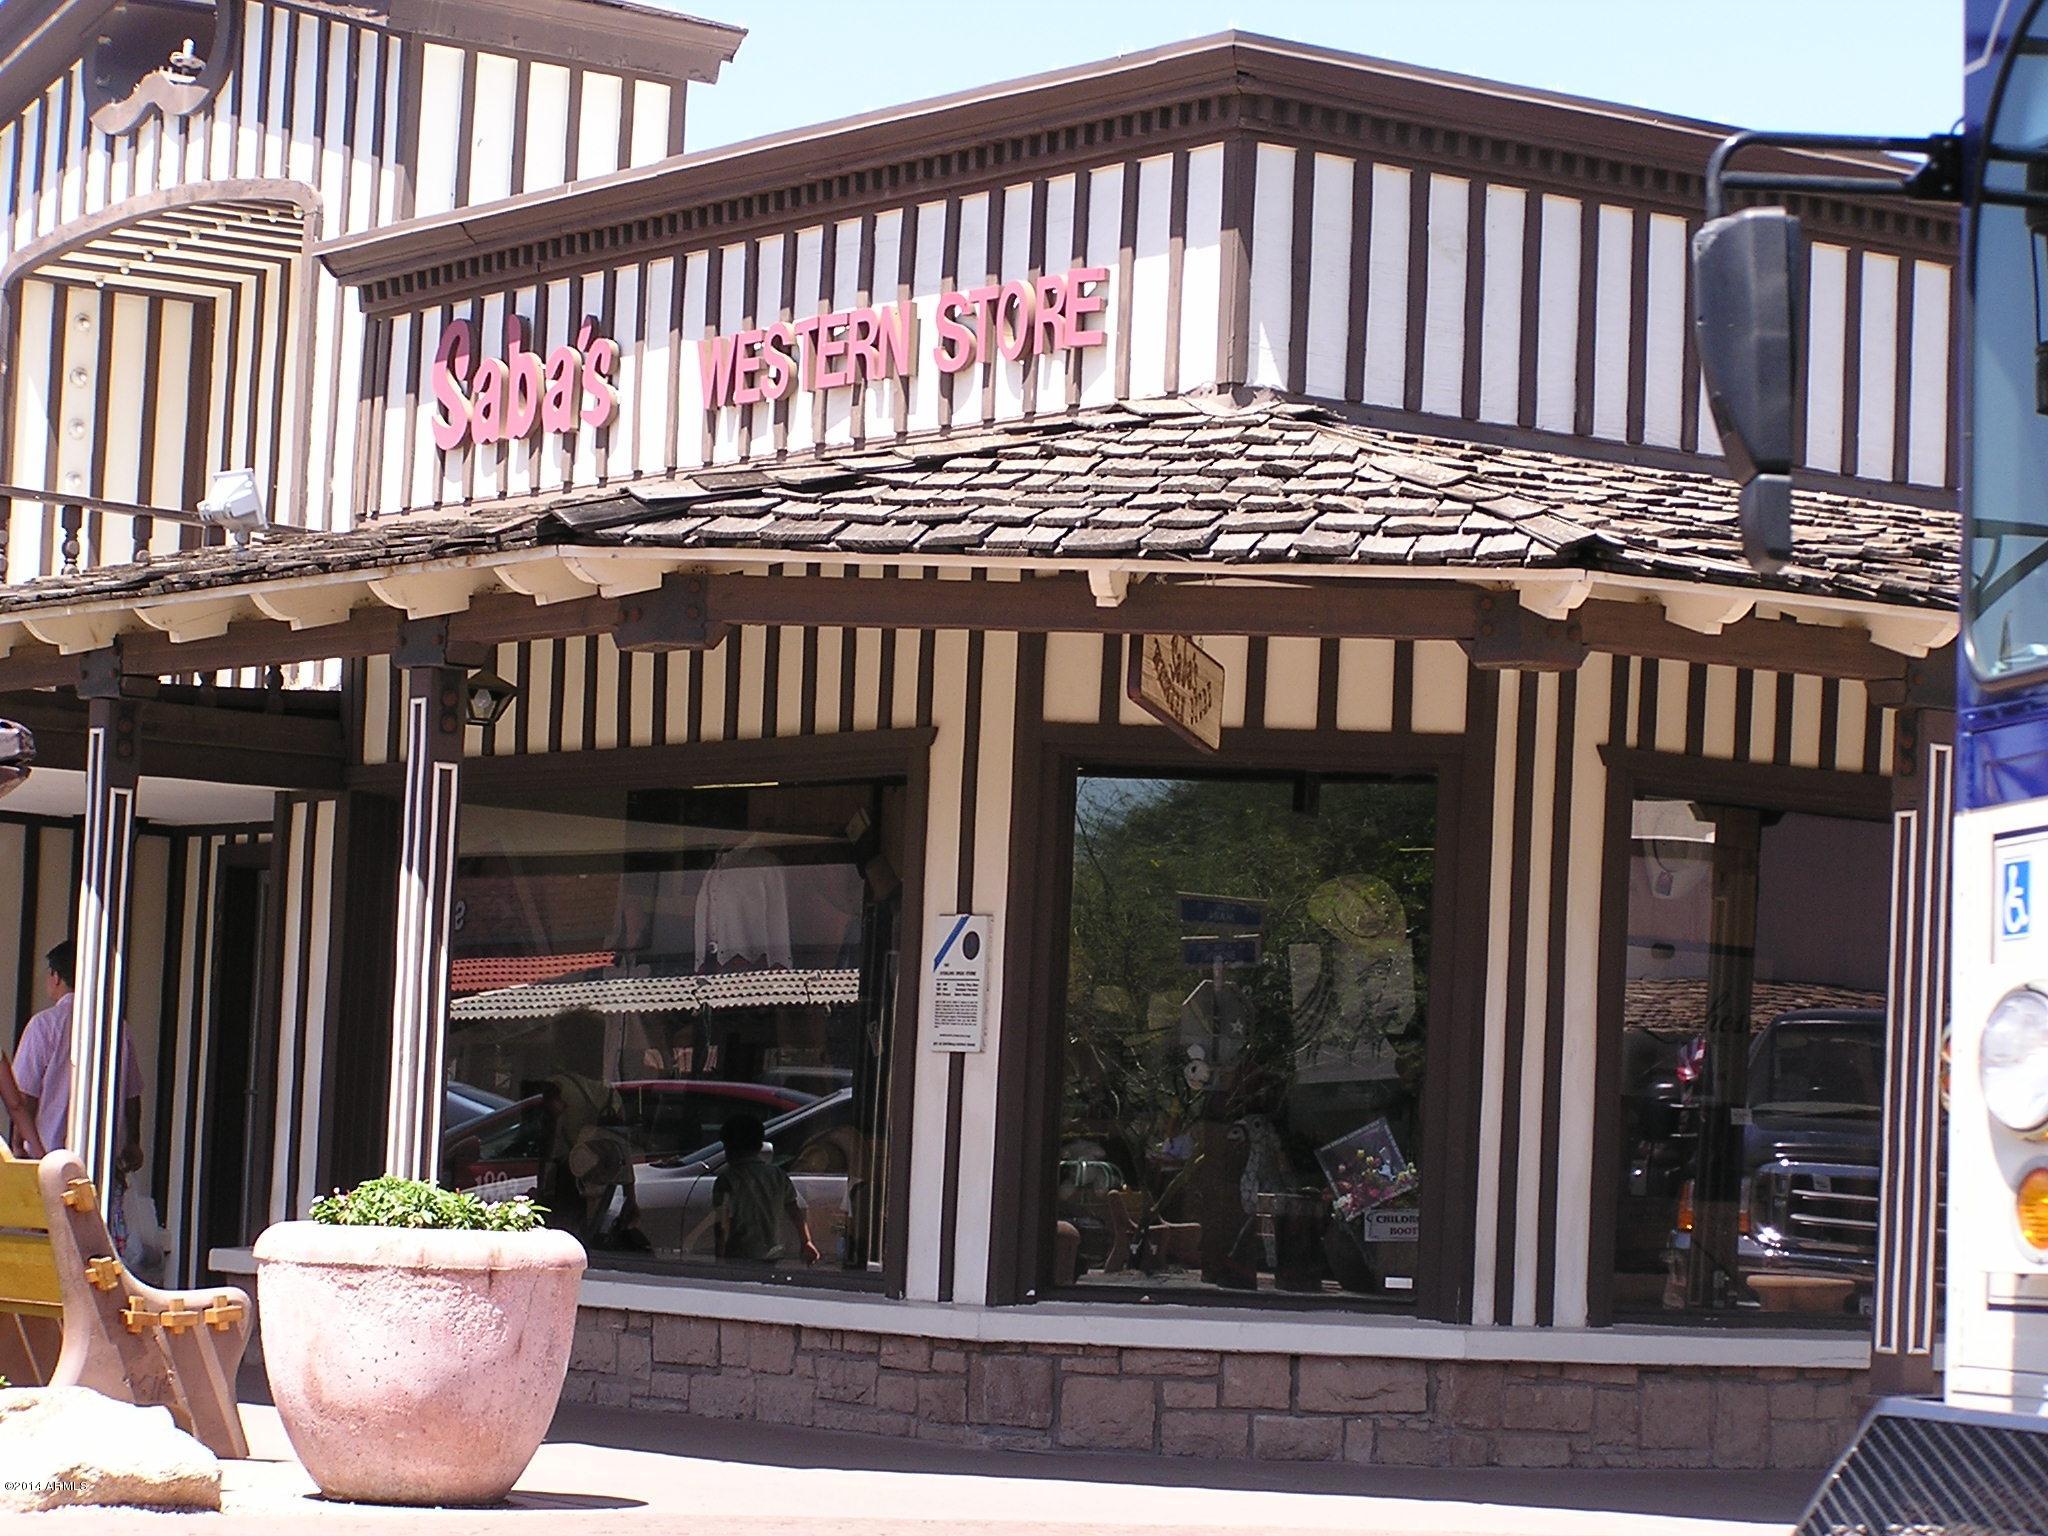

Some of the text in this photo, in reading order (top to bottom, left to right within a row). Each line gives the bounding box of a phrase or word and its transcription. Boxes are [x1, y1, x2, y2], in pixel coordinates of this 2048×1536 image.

[431, 314, 620, 451] Saba's
[698, 267, 1109, 410] WESTERN STORE
